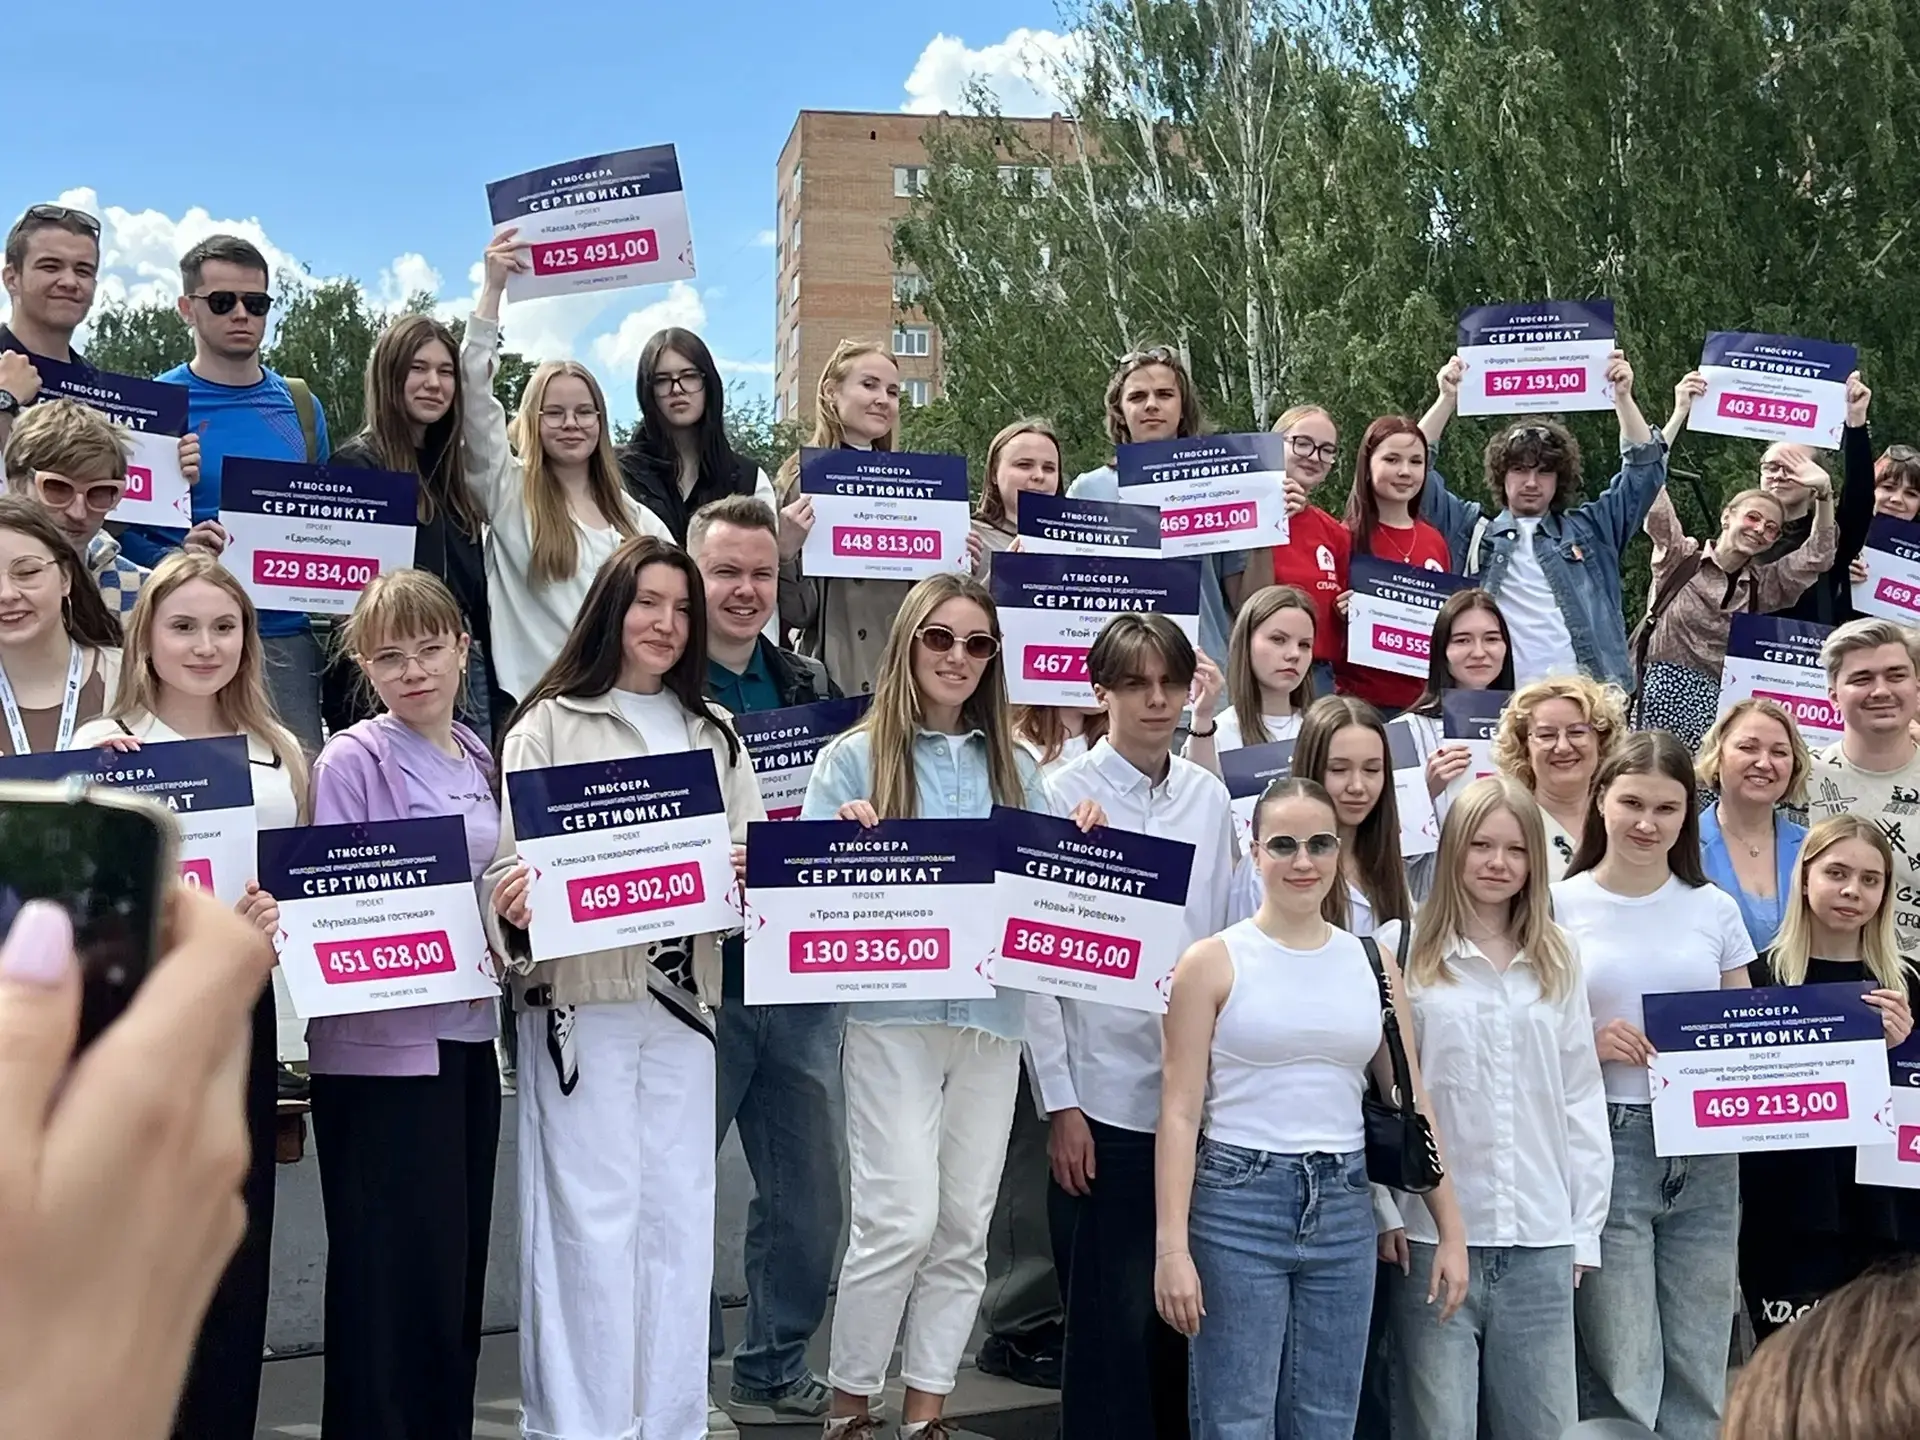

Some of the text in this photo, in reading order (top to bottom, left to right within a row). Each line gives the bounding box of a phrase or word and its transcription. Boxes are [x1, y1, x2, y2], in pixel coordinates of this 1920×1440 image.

[551, 169, 613, 186] АТМОСФЕРА
[530, 184, 641, 212] СЕРТИФИКАТ
[541, 215, 640, 233] «Каскад приключений»
[542, 238, 649, 267] 425 491,00
[1509, 315, 1560, 324] АТМОСФЕРА
[1489, 330, 1581, 343] СЕРТИФИКАТ
[1754, 346, 1803, 358] АТМОСФЕРА
[1731, 358, 1821, 378] СЕРТИФИКАТ
[61, 381, 121, 400] АТМОСФЕРА
[1493, 373, 1579, 391] 367 191,00
[1726, 399, 1810, 422] 403 113,00
[1173, 448, 1227, 459] АТМОСФЕРА
[857, 466, 911, 476] АТМОСФЕРА
[1152, 462, 1249, 482] СЕРТИФИКАТ
[289, 481, 353, 493] АТМОСФЕРА
[836, 483, 934, 498] СЕРТИФИКАТ
[262, 500, 377, 521] СЕРТИФИКАТ
[1061, 512, 1109, 523] АТМОСФЕРА
[1160, 515, 1190, 532] 469
[1194, 508, 1251, 529] 281,00
[841, 533, 935, 555] 448 813,00
[1044, 527, 1130, 545] СЕРТИФИКАТ
[263, 559, 371, 585] 229 834,00
[1062, 573, 1129, 584] АТМОСФЕРА
[1393, 574, 1436, 589] АТМОСФЕРА
[1033, 594, 1156, 612] СЕРТИФИКАТ
[1376, 587, 1444, 609] СЕРТИФИКА
[1882, 585, 1911, 603] 469
[1059, 628, 1090, 638] «Твой
[1790, 635, 1825, 646] АТМОС
[1378, 631, 1430, 655] 469 555
[1033, 654, 1073, 673] 467
[1764, 650, 1824, 667] СЕРТИ
[584, 779, 650, 796] АТМОСФЕРА
[562, 802, 682, 831] СЕРТИФИКАТ
[327, 844, 396, 859] АТМОСФЕРА
[551, 838, 712, 867] «Комната психологической помощи»
[829, 842, 909, 852] АТМОСФЕРА
[1058, 840, 1124, 861] АТМОСФЕРА
[303, 869, 428, 895] СЕРТИФИКАТ
[797, 867, 942, 884] СЕРТИФИКАТ
[1025, 860, 1146, 895] СЕРТИФИКАТ
[580, 872, 695, 911] 469 302,00
[852, 892, 885, 900] ПРОЕКТ
[355, 897, 384, 907] ПРОЕКТ
[1033, 899, 1126, 923] «Новый Уровень»
[312, 909, 435, 930] «Музыкальная гостиная»
[809, 908, 934, 922] «Тропа разведчиков»
[329, 941, 444, 974] 451 628,00
[802, 938, 939, 965] 130 336,00
[1014, 929, 1130, 969] 368 916,00
[1723, 1006, 1799, 1018] АТМОСФЕРА
[1695, 1027, 1833, 1048] СЕРТИФИКАТ
[1679, 1066, 1724, 1076] «Создание
[1706, 1091, 1837, 1118] 469 213,00
